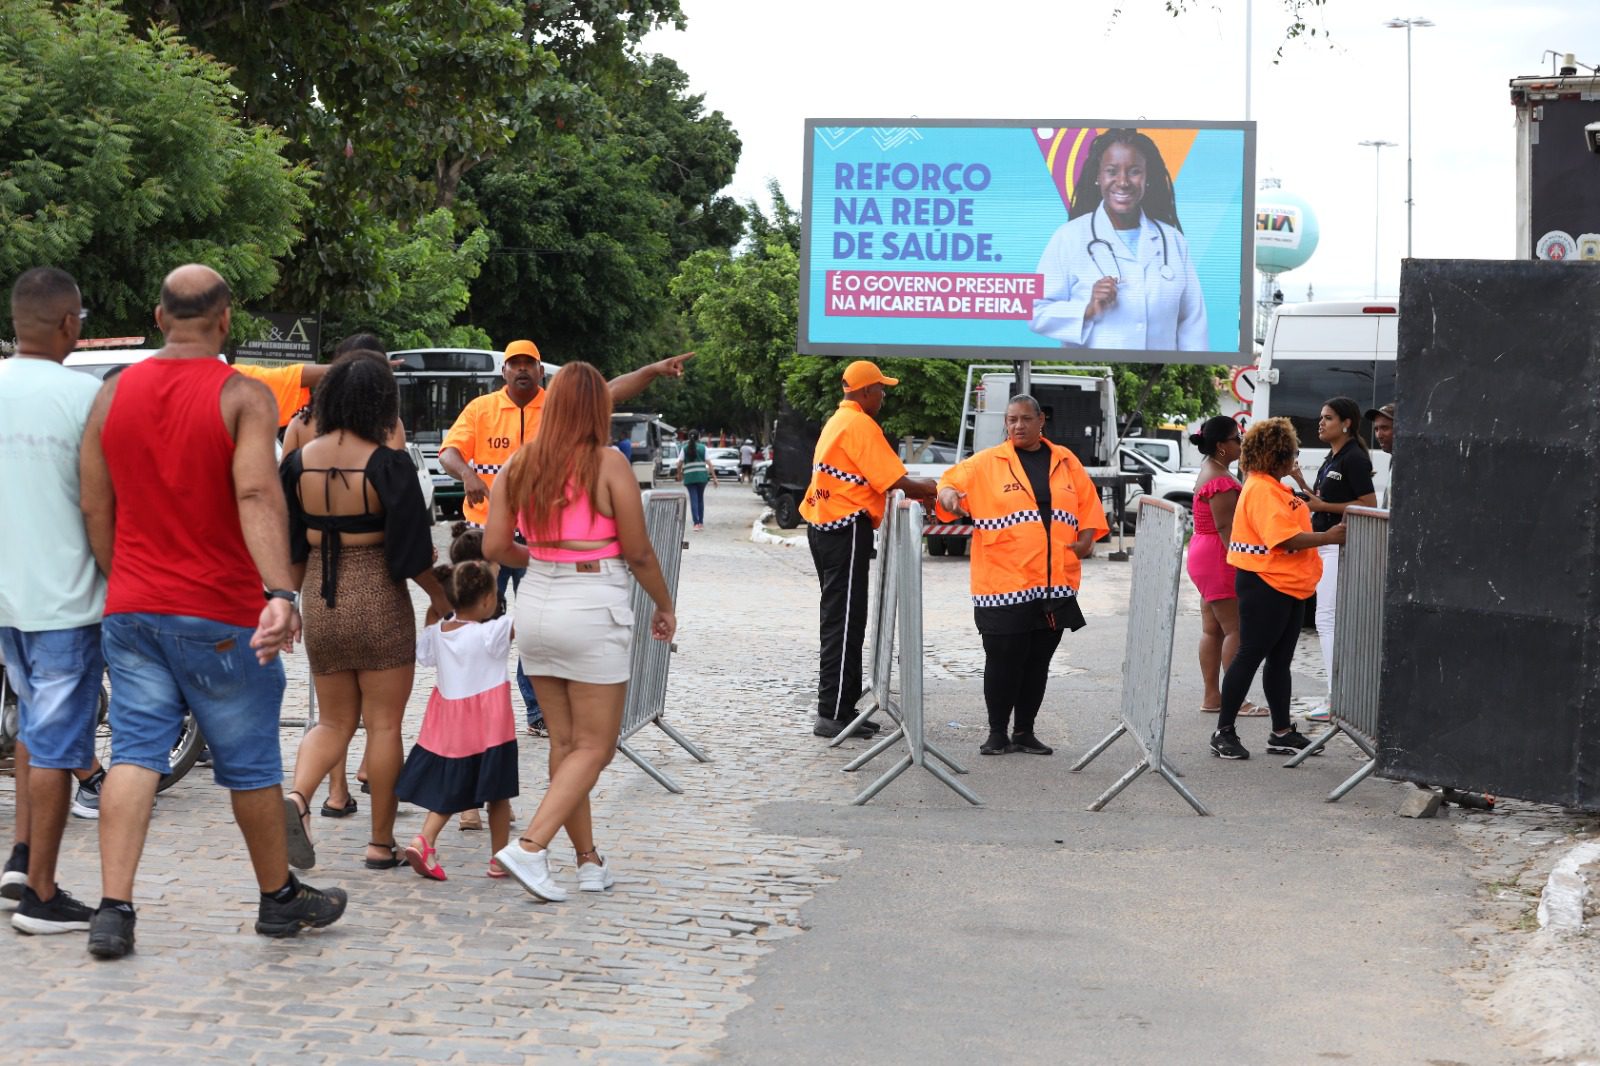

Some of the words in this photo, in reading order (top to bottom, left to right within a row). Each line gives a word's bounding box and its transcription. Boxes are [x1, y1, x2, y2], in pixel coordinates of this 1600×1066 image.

[835, 162, 991, 194] REFORÇO
[834, 197, 883, 225] NA
[892, 198, 974, 226] REDE
[1256, 214, 1294, 233] HIA
[833, 232, 874, 260] DE
[881, 228, 1003, 262] SAÚDE.
[832, 271, 842, 291] É
[845, 275, 861, 292] O
[864, 276, 952, 293] GOVERNO
[956, 278, 1036, 294] PRESENTE
[831, 295, 856, 311] NA
[860, 295, 945, 312] MICARETA
[948, 297, 971, 313] DE
[975, 298, 1028, 314] FEIRA.
[248, 340, 311, 351] EMPREENDIMENTOS
[487, 437, 510, 449] 109
